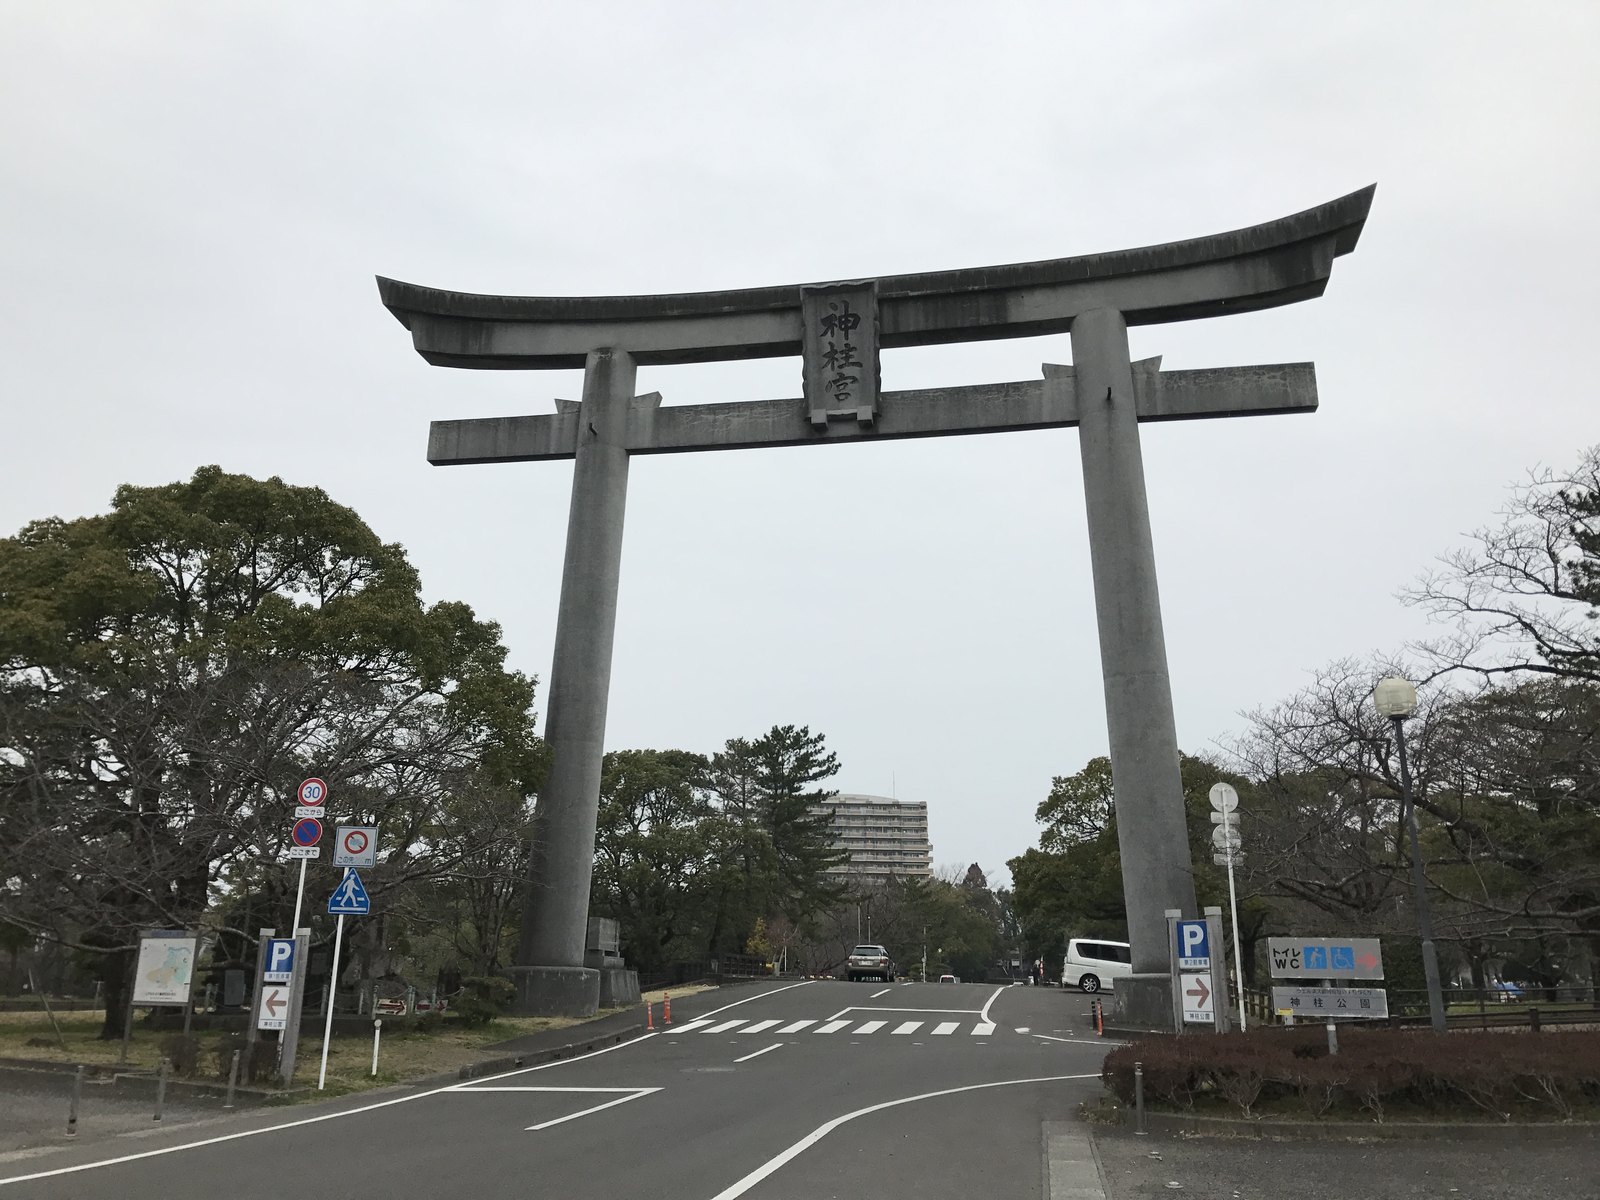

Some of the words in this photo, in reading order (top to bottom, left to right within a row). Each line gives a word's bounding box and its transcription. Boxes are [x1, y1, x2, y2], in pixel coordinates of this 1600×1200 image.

[819, 300, 863, 402] 神柱宮
[304, 786, 321, 799] 30
[297, 808, 322, 816] ここから
[291, 849, 318, 857] ここまで
[1183, 925, 1204, 957] P
[270, 942, 291, 971] P
[1272, 947, 1301, 958] トイレ
[1274, 958, 1300, 969] WC
[1290, 997, 1371, 1009] 神柱公園
